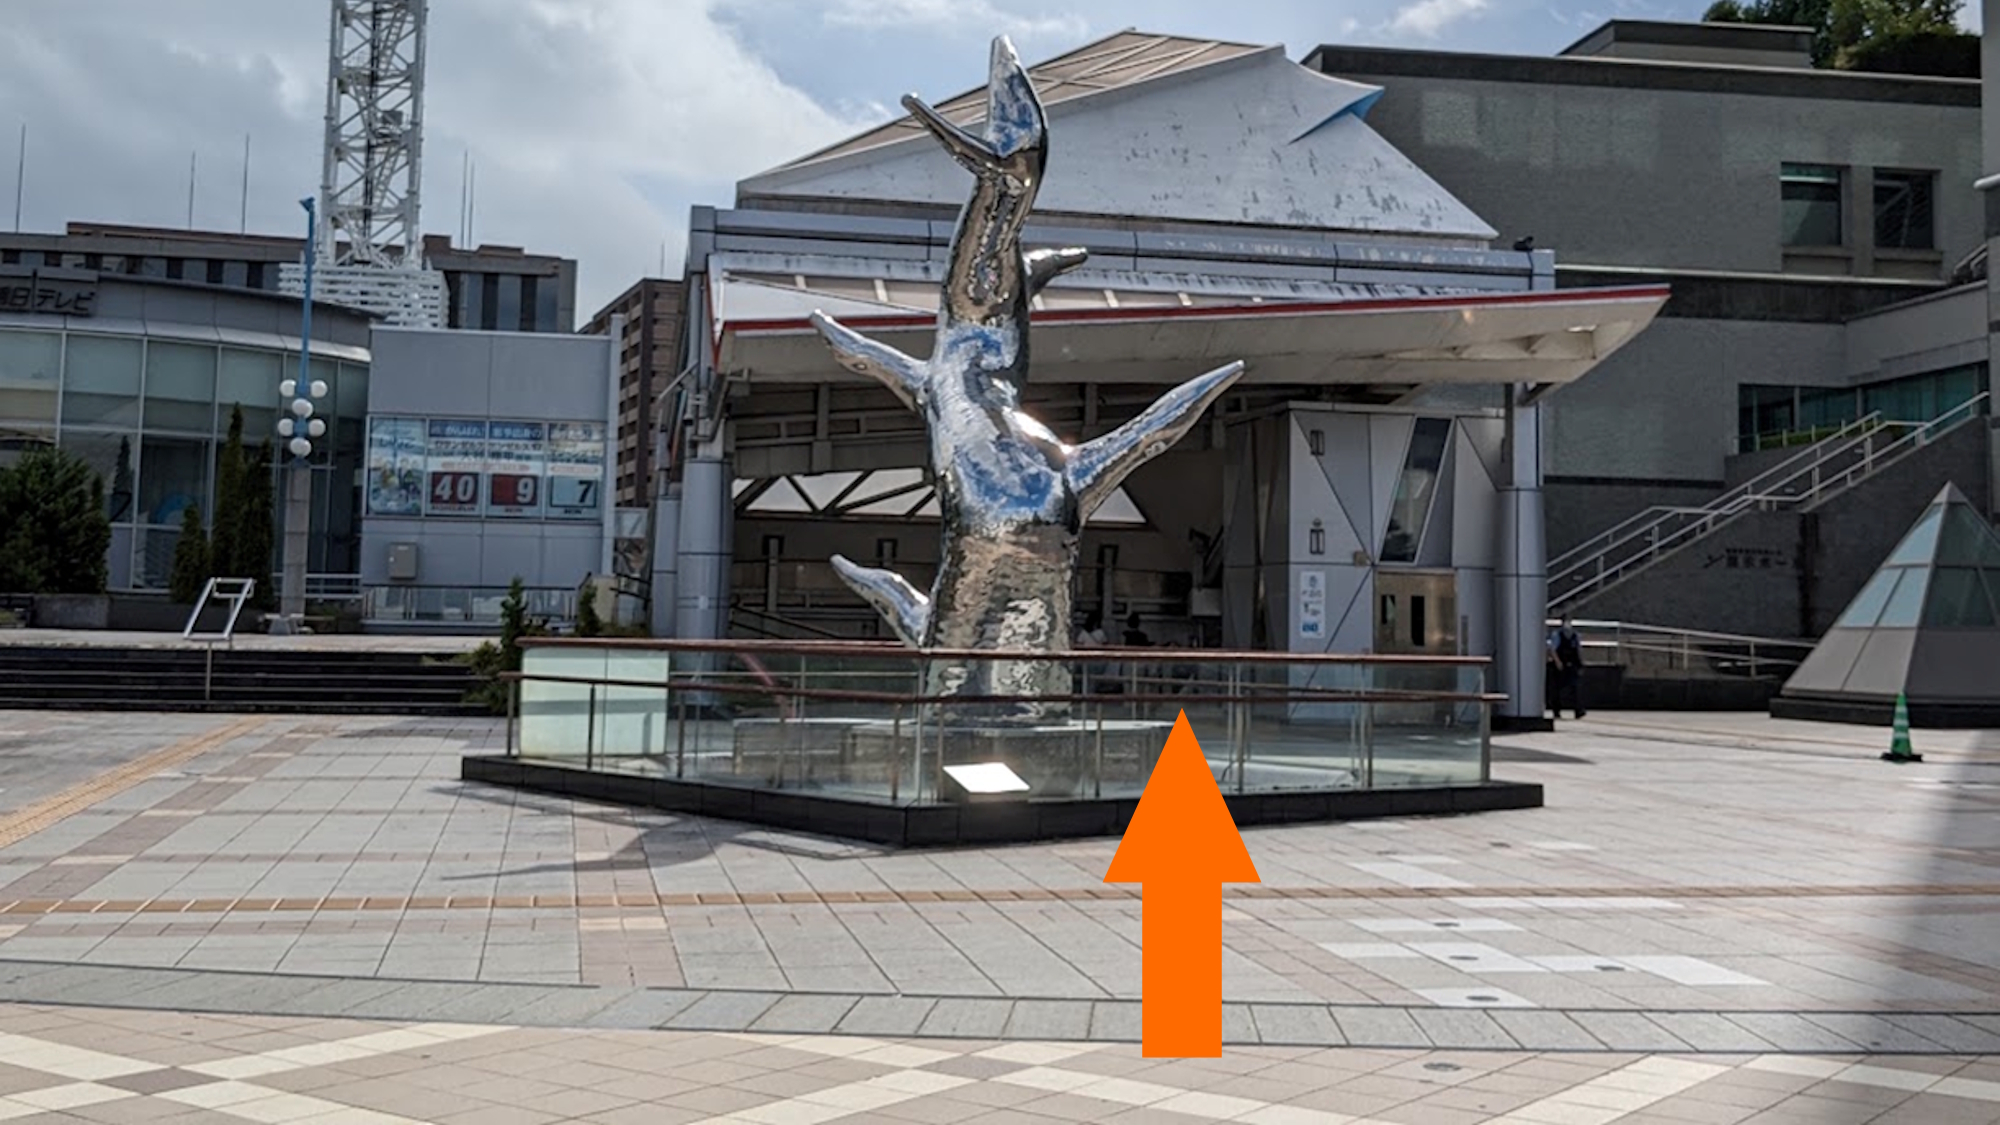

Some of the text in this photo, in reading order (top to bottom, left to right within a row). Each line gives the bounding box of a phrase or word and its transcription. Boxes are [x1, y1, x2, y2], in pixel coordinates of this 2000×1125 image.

[435, 474, 475, 502] 40
[516, 477, 535, 503] 9
[578, 480, 594, 503] 7
